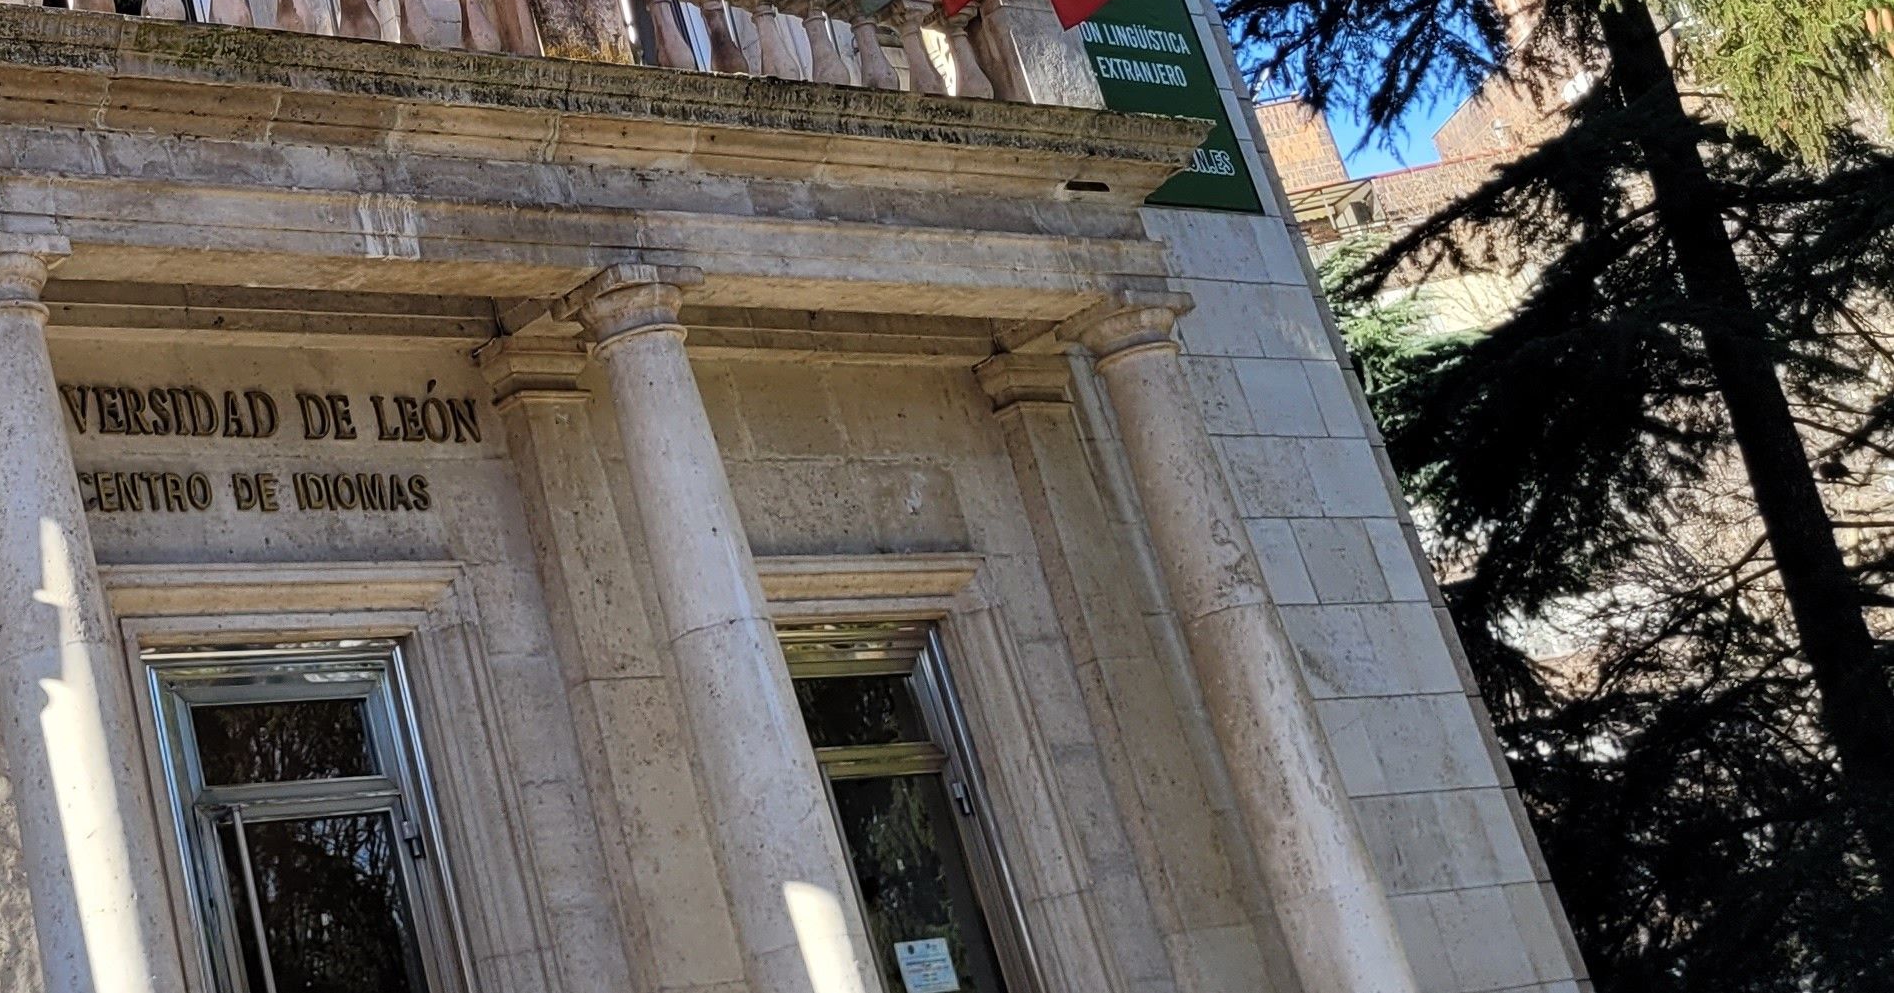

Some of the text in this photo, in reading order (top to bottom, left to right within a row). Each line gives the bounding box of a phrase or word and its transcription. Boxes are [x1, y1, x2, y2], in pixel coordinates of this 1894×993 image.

[1103, 23, 1192, 56] LINGÜÍSTICA
[1095, 55, 1188, 88] EXTRANJERO
[59, 379, 483, 444] VERSIDAD DE LEÓN
[232, 472, 280, 512] DE
[293, 472, 433, 512] IDIOMAS
